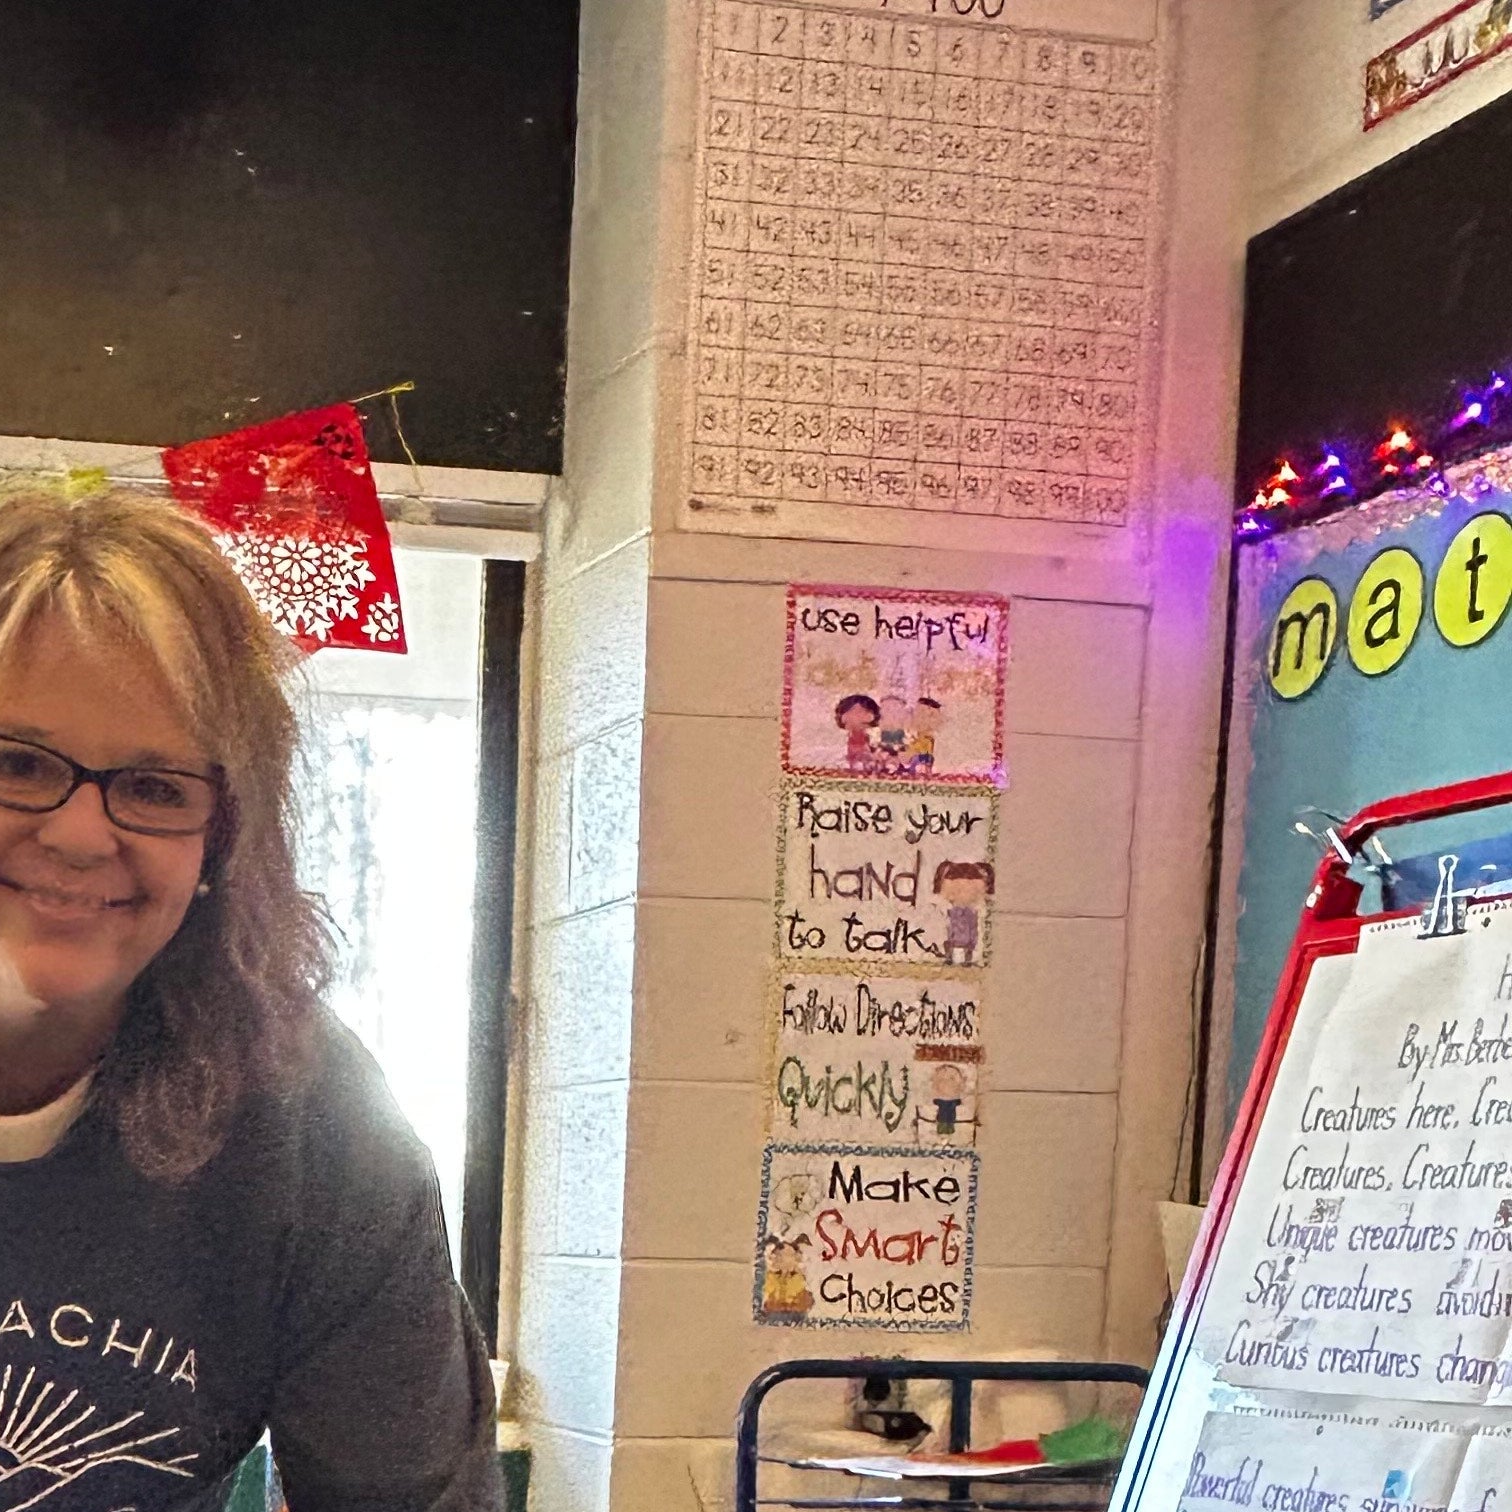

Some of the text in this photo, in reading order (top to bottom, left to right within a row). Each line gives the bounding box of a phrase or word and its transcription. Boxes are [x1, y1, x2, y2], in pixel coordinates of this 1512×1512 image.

[714, 110, 741, 137] 21
[759, 114, 792, 142] 22
[708, 210, 736, 236] 41
[844, 223, 876, 249] 44
[746, 409, 778, 435] 82
[801, 604, 990, 651] use helpful
[1272, 537, 1488, 678] mat
[796, 792, 982, 844] Raise your
[785, 908, 826, 950] to
[1398, 1022, 1429, 1082] By
[777, 1055, 911, 1133] Quickly
[1300, 1086, 1396, 1132] Creatures
[827, 1160, 960, 1204] Make
[815, 1208, 962, 1265] Smart
[1348, 1201, 1458, 1251] creatures
[820, 1273, 960, 1315] Choices
[1301, 1263, 1413, 1314] creatures
[1318, 1325, 1421, 1378] creatures
